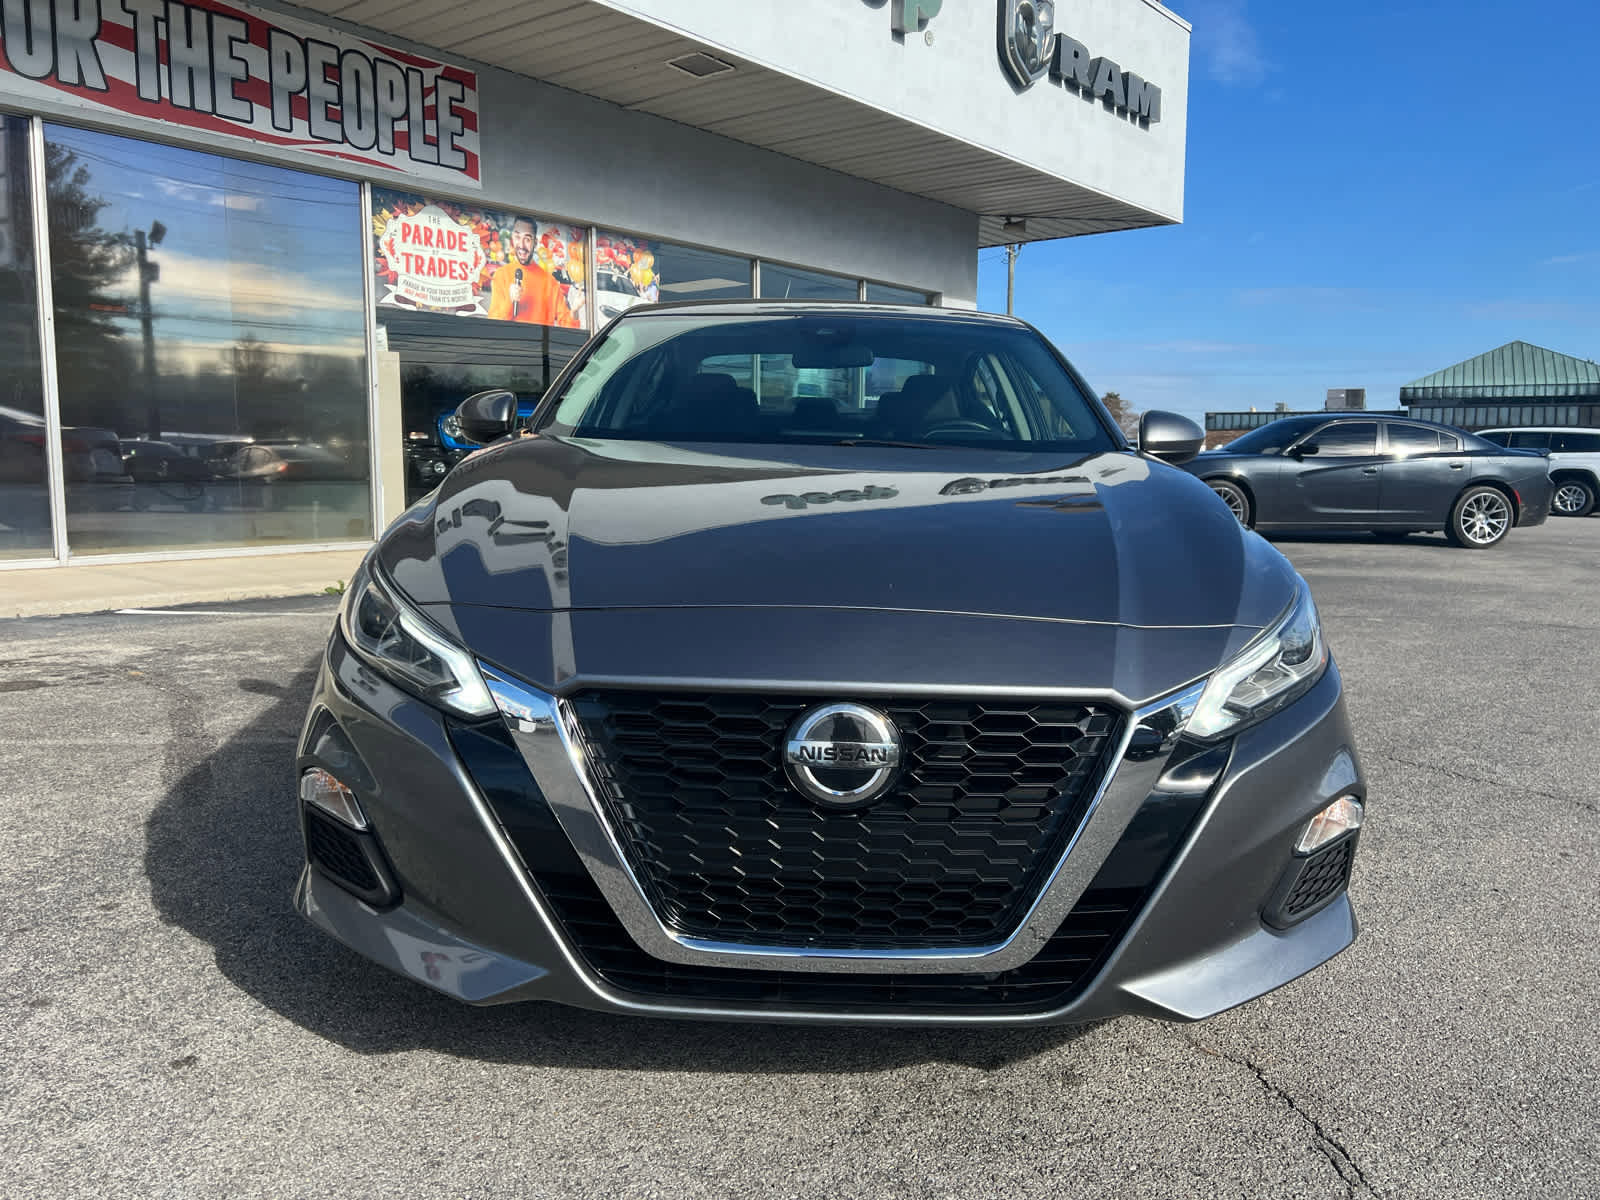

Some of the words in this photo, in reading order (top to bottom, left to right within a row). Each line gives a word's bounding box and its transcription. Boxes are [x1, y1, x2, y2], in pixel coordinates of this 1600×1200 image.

[121, 0, 253, 124] THE
[267, 27, 467, 171] PEOPLE
[1050, 32, 1161, 124] RAM
[428, 215, 441, 226] THE
[401, 223, 468, 251] PARADE
[401, 252, 469, 281] TRADES
[799, 745, 887, 762] NISSAN
